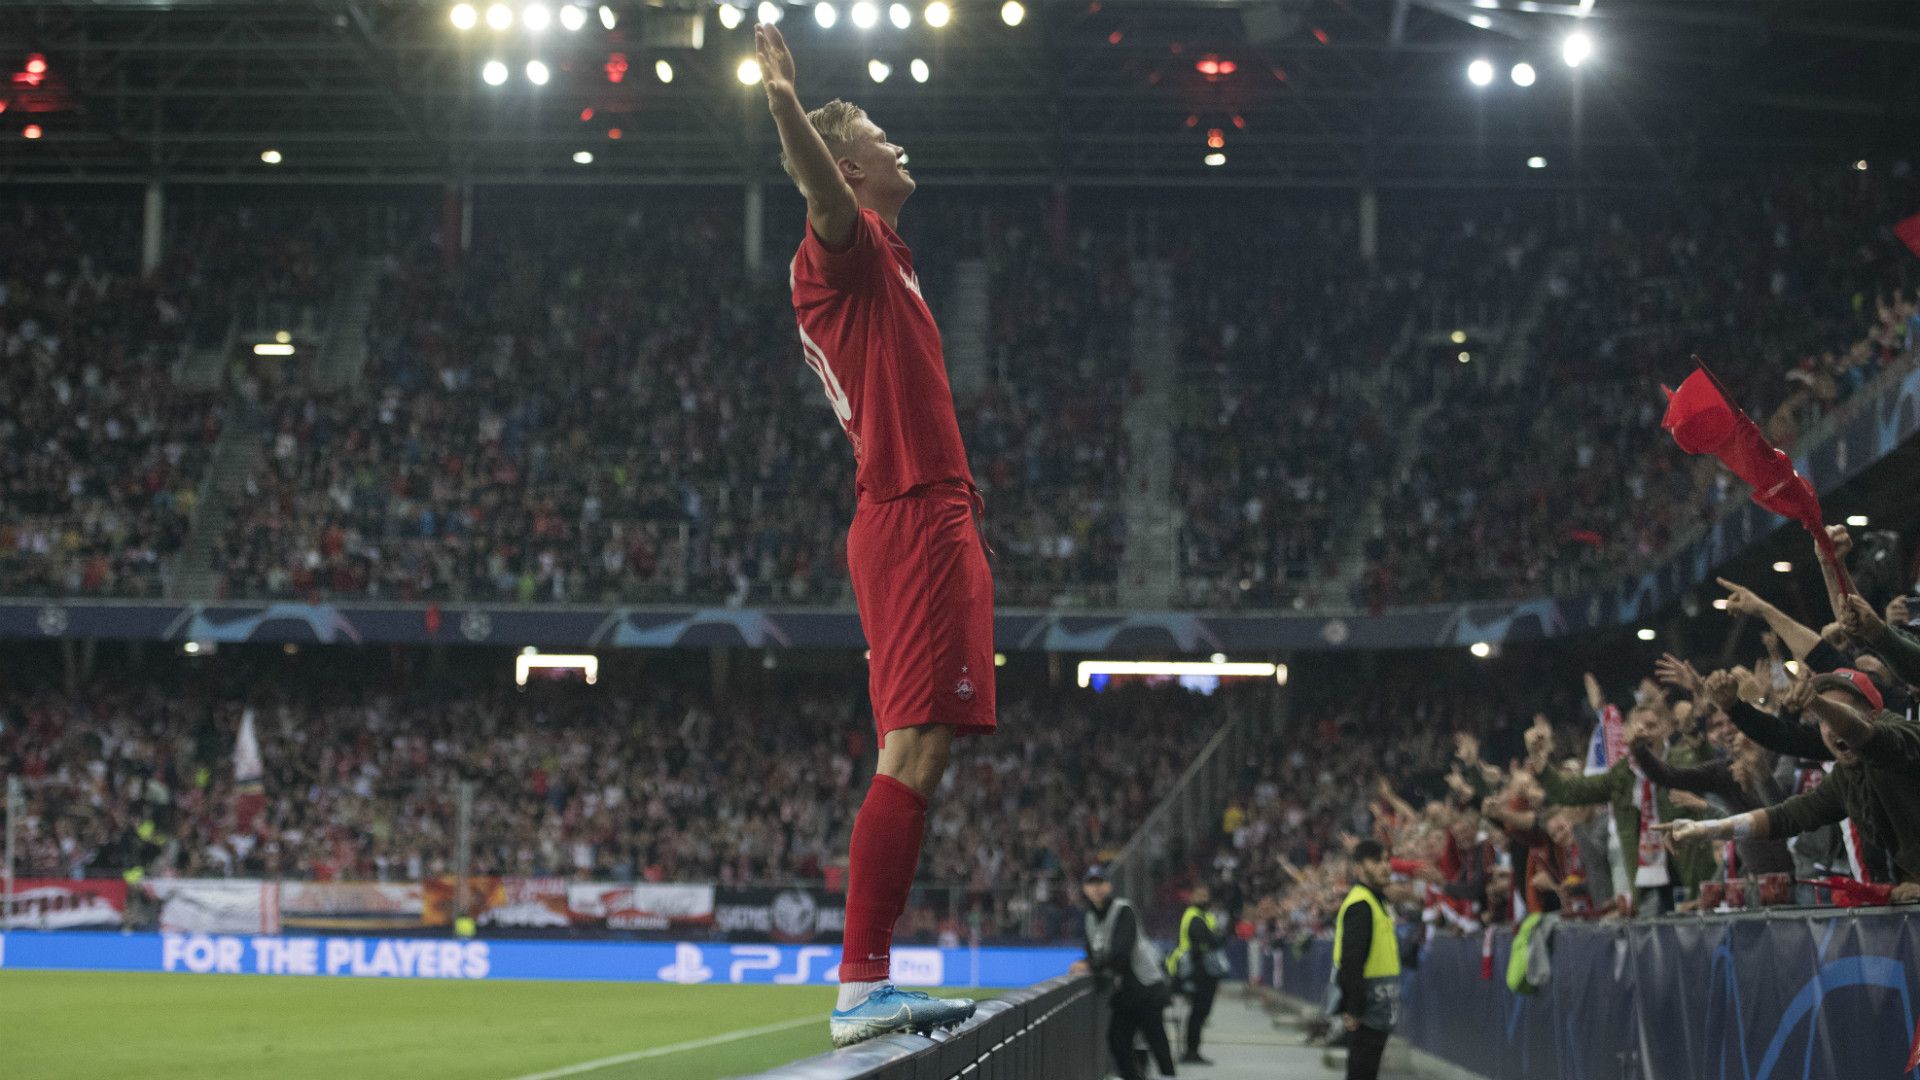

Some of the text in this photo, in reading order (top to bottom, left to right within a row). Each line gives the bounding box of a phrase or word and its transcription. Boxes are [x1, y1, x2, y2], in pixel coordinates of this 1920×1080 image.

[162, 935, 490, 979] FOR THE PLAYERS
